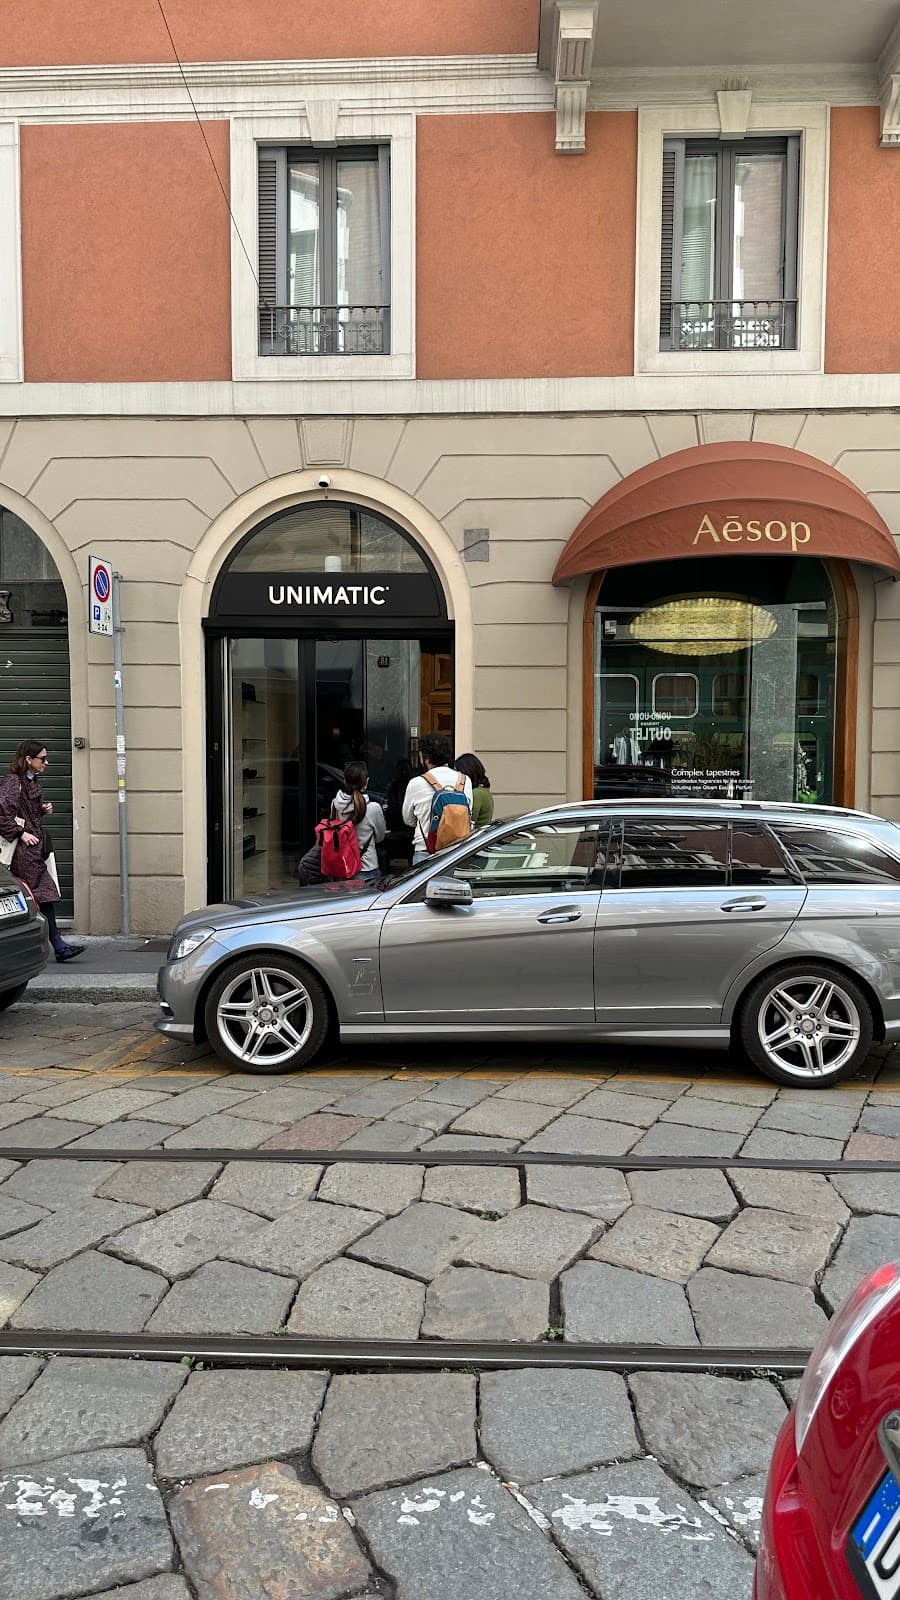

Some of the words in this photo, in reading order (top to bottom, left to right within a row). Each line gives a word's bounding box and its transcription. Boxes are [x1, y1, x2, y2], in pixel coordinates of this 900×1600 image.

[692, 514, 811, 552] Aēsop
[671, 768, 704, 778] Complex
[706, 768, 740, 778] tapestries
